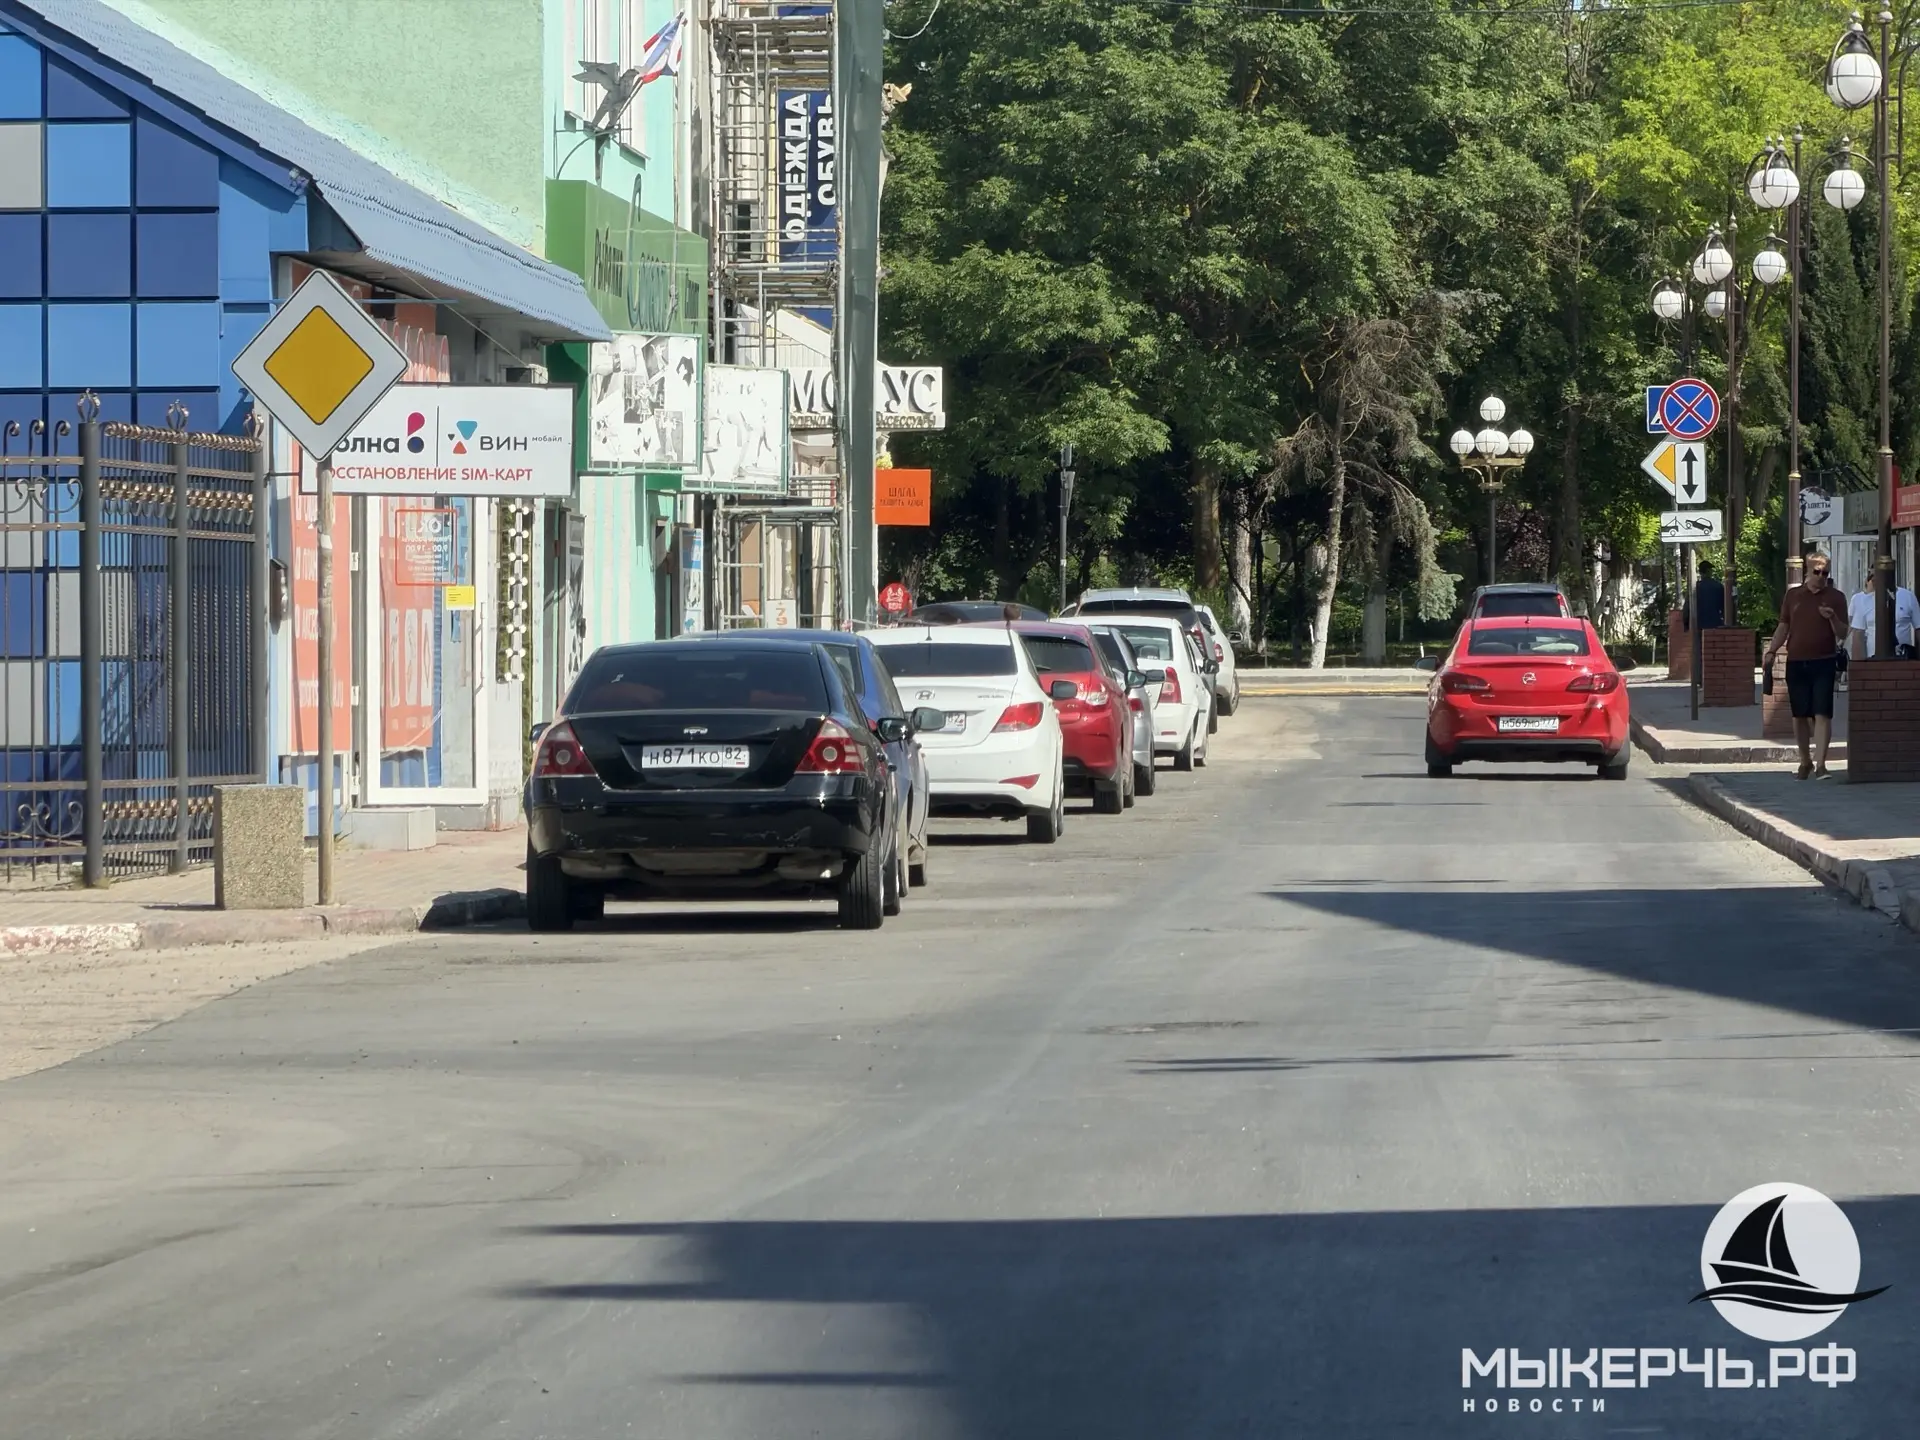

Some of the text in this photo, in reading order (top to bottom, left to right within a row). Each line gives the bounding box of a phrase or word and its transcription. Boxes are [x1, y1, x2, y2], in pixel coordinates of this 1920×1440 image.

[818, 94, 836, 206] ОБУВЬ
[784, 93, 812, 241] ОДЕЖДА
[790, 368, 937, 414] МОУС
[334, 436, 400, 453] олна
[480, 435, 563, 451] ВИН мобайл
[328, 466, 533, 482] ССТАНОВЛЕНИЕ SIM-КАРТ
[650, 747, 742, 765] Н871КО 82
